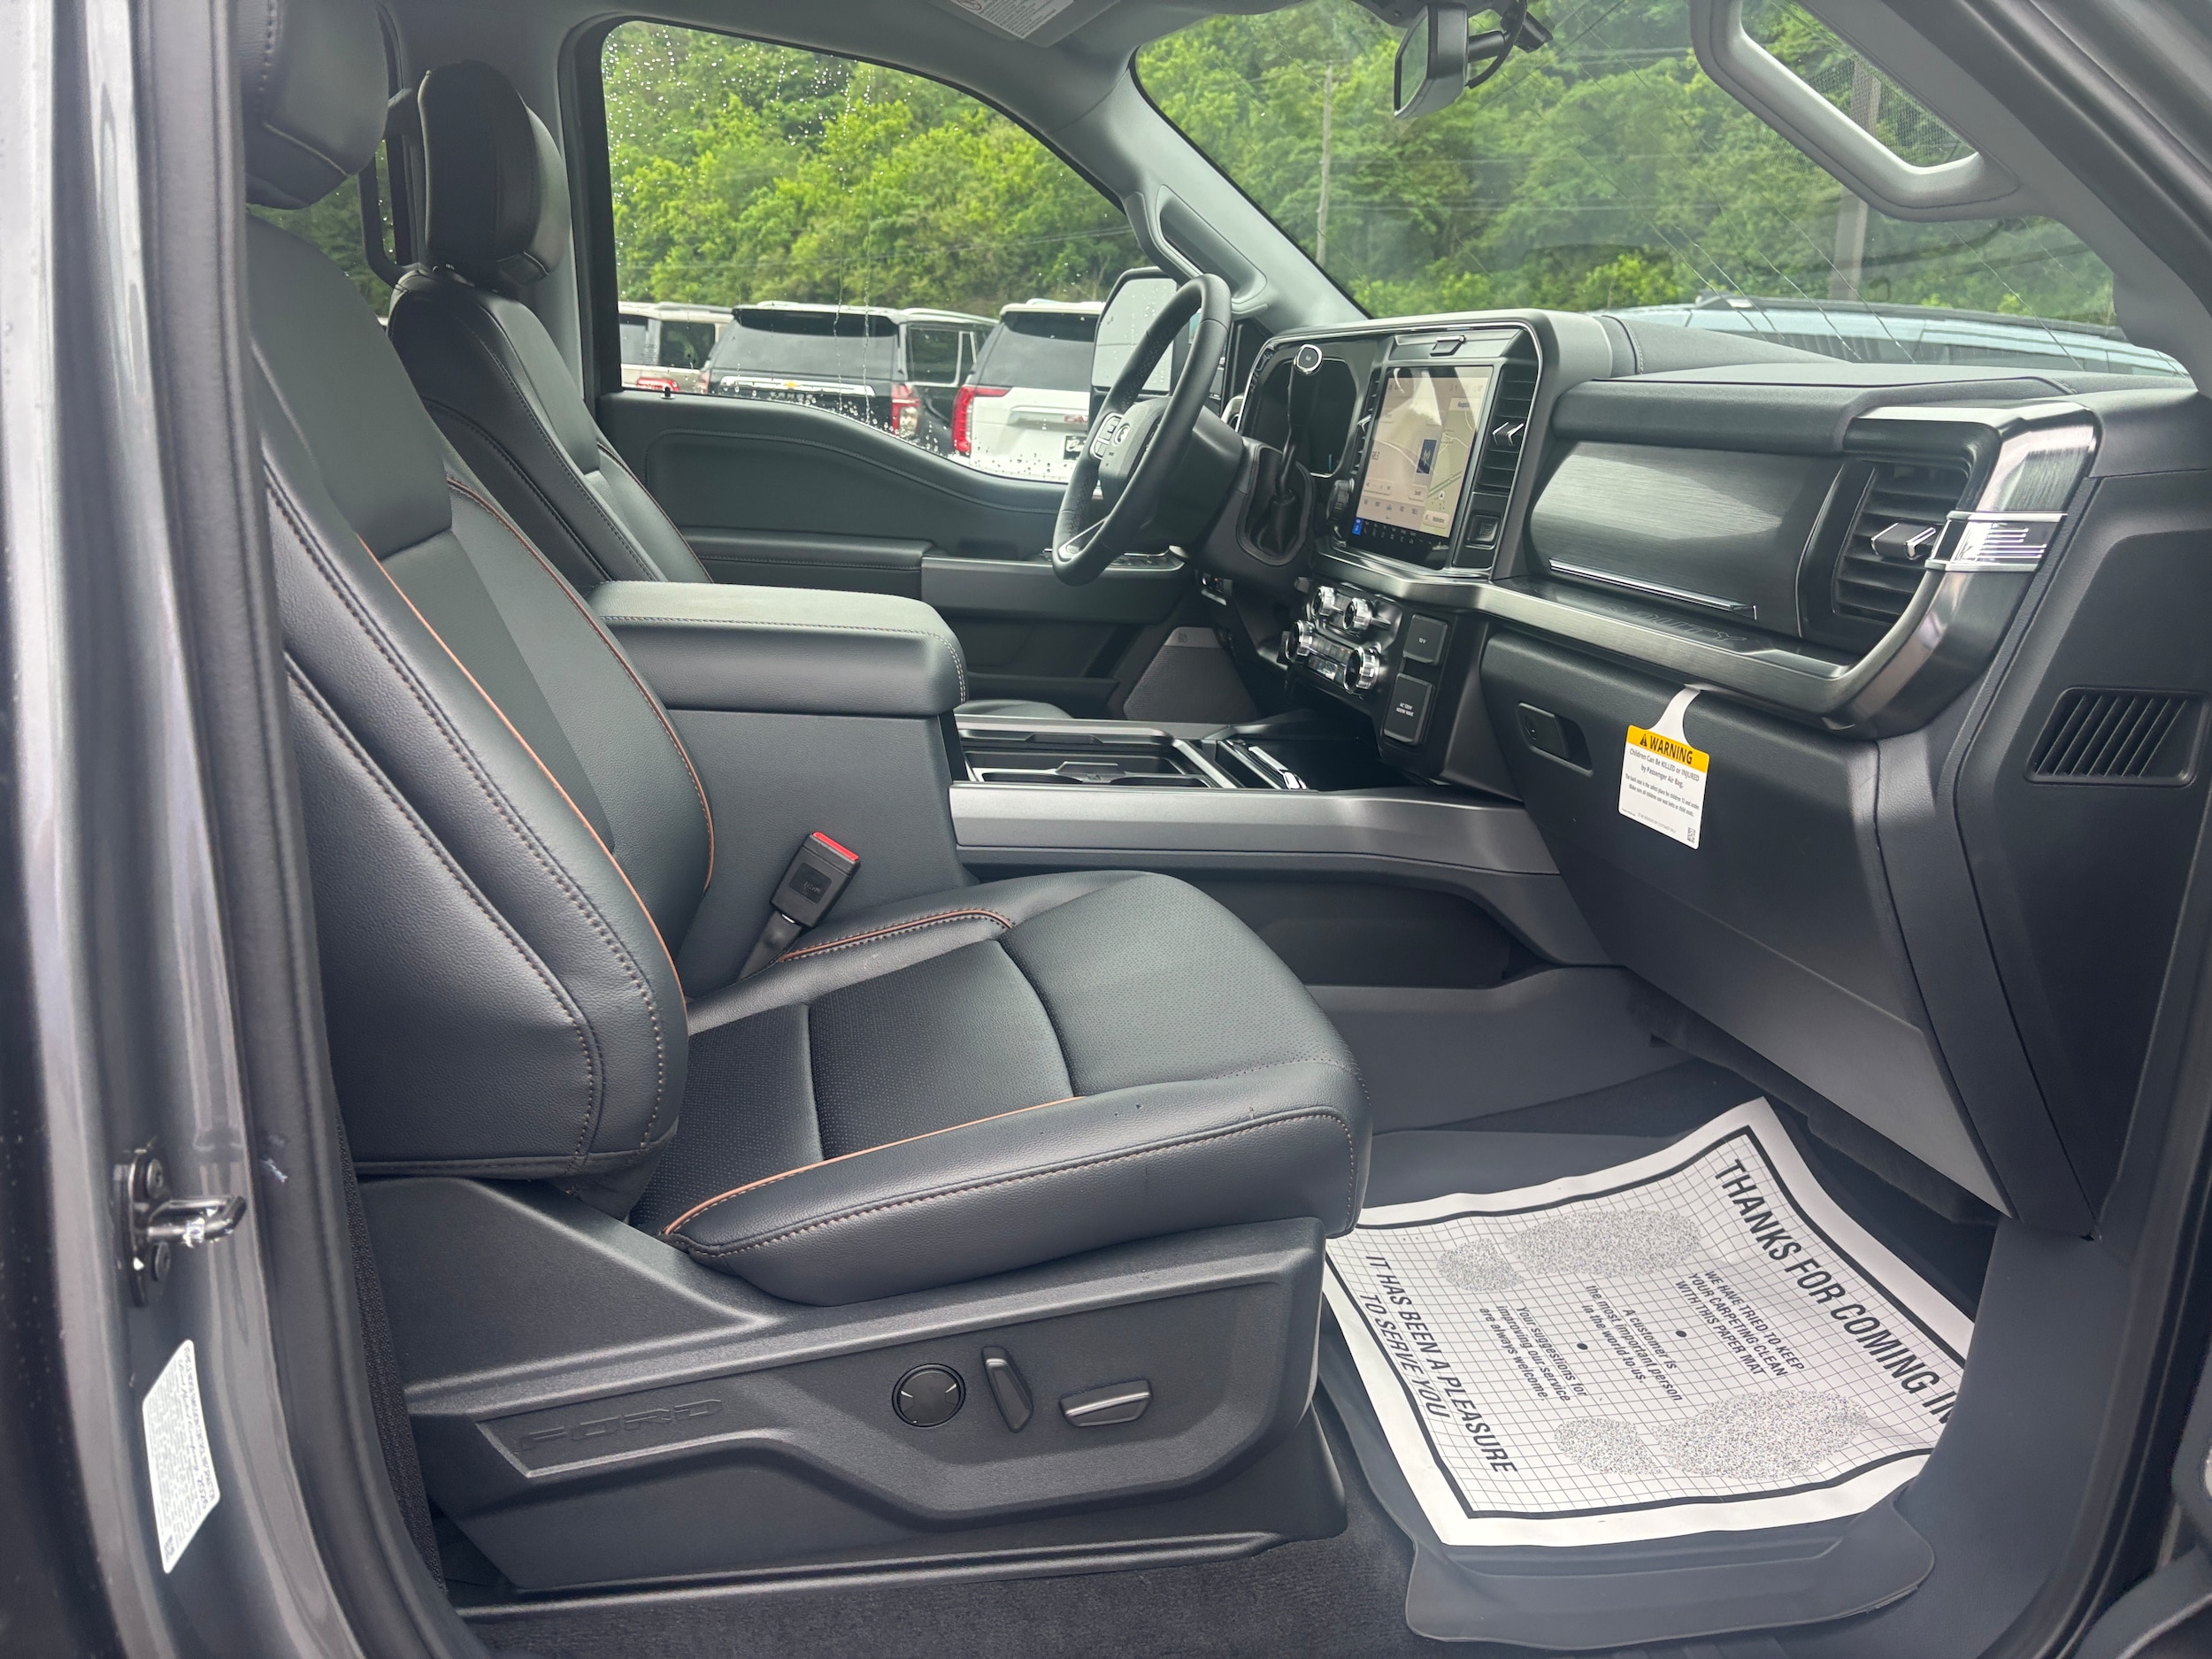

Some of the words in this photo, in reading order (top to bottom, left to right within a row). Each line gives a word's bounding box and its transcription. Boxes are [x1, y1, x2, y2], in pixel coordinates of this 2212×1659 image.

[1630, 748, 1646, 760] Children
[1662, 761, 1676, 772] KILLED
[1681, 769, 1700, 783] INJURED
[1641, 764, 1646, 773] by
[1647, 767, 1667, 782] Passenger
[1649, 735, 1694, 765] WARNING
[1366, 1256, 1392, 1270] IT
[1376, 1274, 1412, 1305] HAS
[1715, 1159, 1801, 1261] THANKS
[1785, 1257, 1846, 1305] FOR
[1831, 1303, 1939, 1394] COMING
[1359, 1294, 1387, 1315] TO
[1375, 1317, 1425, 1375] SERVE
[1411, 1379, 1451, 1418] YOU
[1398, 1310, 1442, 1354] BEEN
[1479, 1308, 1495, 1322] are
[1490, 1324, 1518, 1355] always
[1513, 1356, 1548, 1402] welcome.
[1496, 1305, 1533, 1348] improving
[1528, 1349, 1546, 1365] our
[1540, 1367, 1571, 1402] service
[1517, 1307, 1536, 1326] Your
[1531, 1327, 1576, 1381] suggestions
[1571, 1383, 1588, 1396] for
[1586, 1285, 1601, 1299] the
[1598, 1301, 1622, 1322] most
[1615, 1324, 1657, 1367] important
[1647, 1369, 1683, 1401] person
[1590, 1315, 1606, 1329] the
[1602, 1331, 1630, 1356] world
[1623, 1357, 1635, 1367] to
[1631, 1369, 1646, 1383] us.
[1630, 1317, 1670, 1358] customer
[1664, 1360, 1677, 1369] is
[1675, 1280, 1701, 1304] WITH
[1695, 1304, 1719, 1325] THIS
[1713, 1325, 1746, 1354] PAPER
[1740, 1354, 1766, 1375] MAT
[1688, 1272, 1715, 1298] YOUR
[1709, 1297, 1758, 1344] CARPETING
[1753, 1345, 1788, 1377] CLEAN
[1705, 1271, 1723, 1285] WE
[1720, 1285, 1744, 1305] HAVE
[1739, 1304, 1768, 1332] TRIED
[1763, 1332, 1781, 1345] TO
[1776, 1345, 1805, 1370] KEEP
[1425, 1358, 1451, 1370] A
[519, 1399, 723, 1451] FORD
[1437, 1375, 1518, 1472] PLEASURE
